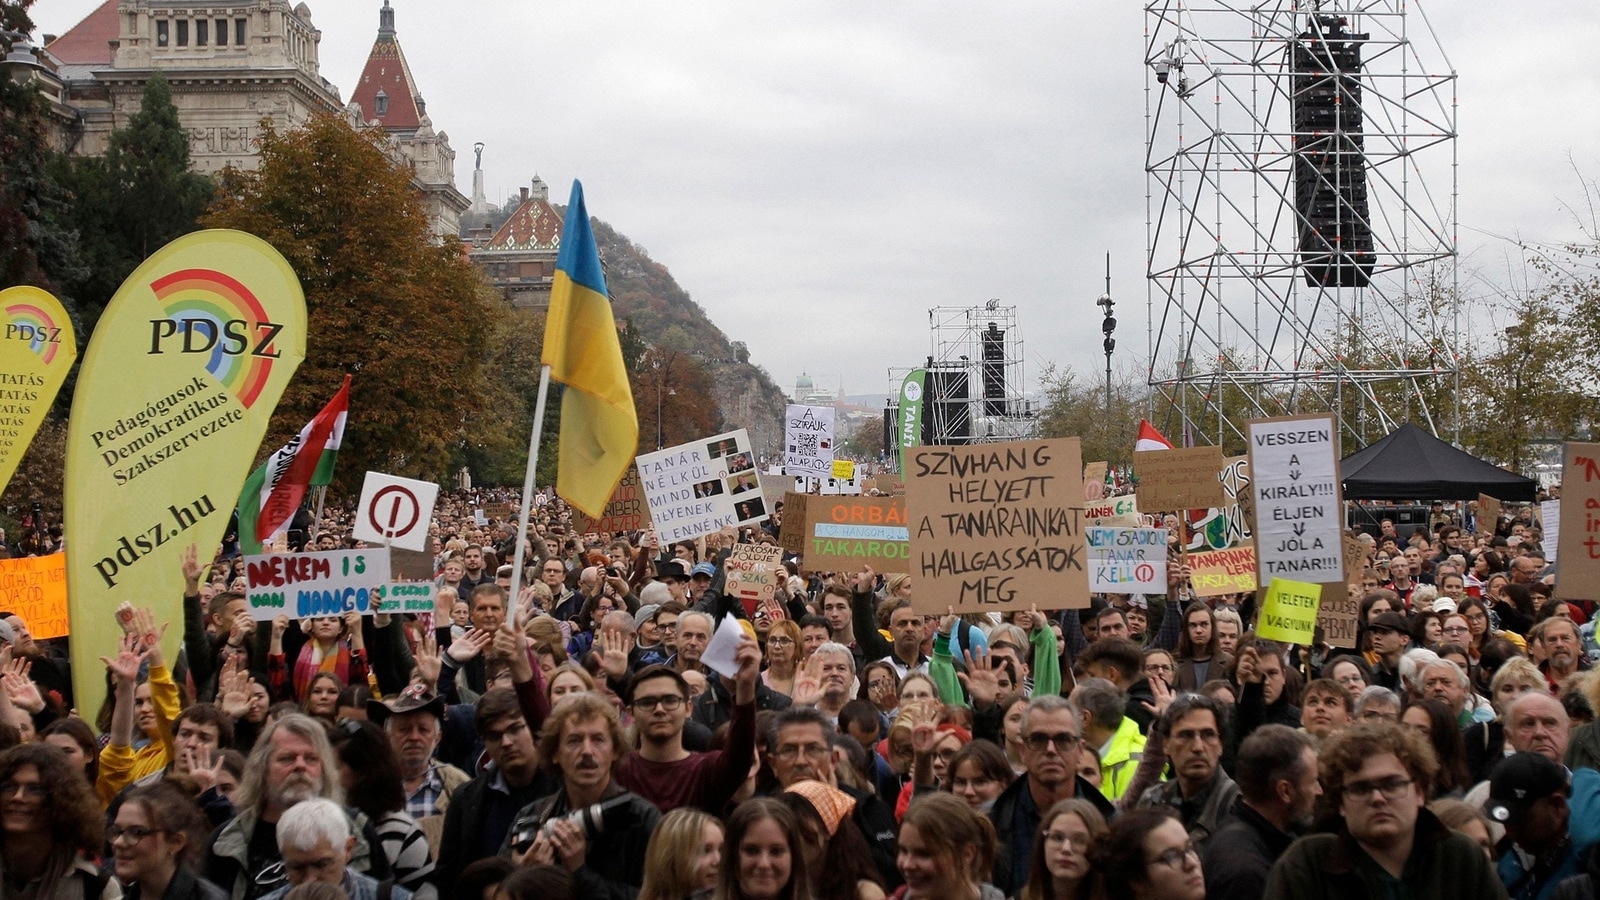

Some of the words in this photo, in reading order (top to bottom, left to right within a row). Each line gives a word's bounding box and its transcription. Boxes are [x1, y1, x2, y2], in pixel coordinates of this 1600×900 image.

[5, 323, 62, 343] PDSZ
[147, 318, 284, 358] PDSZ
[90, 376, 209, 449] Pedagógusok
[803, 408, 814, 420] A
[100, 391, 229, 468] Demokratikus
[1255, 430, 1329, 447] VESSZEN
[112, 407, 244, 486] Szakszervezete
[641, 451, 701, 475] TANÁR
[915, 445, 1051, 479] SZÍVHANG
[1289, 454, 1300, 466] A
[645, 465, 709, 491] NÉLKÜL
[649, 489, 690, 508] MIND
[949, 476, 1054, 503] HELYETT
[1260, 483, 1334, 500] KIRÁLY!!!
[654, 502, 713, 524] ILYENEK
[917, 515, 934, 539] A
[942, 503, 1087, 538] TANÁRAINKAT
[1273, 505, 1324, 521] ÉLJEN
[93, 494, 217, 589] pdsz.hu
[1277, 537, 1308, 552] JÓL
[1313, 538, 1324, 550] A
[921, 538, 1083, 578] HALLGASSÁTOK
[1095, 547, 1147, 565] TANÁR
[1187, 549, 1256, 570] TANÁRNAK
[1266, 556, 1338, 574] TANÁR!!!
[247, 556, 330, 589] NEKEM
[342, 555, 366, 577] IS
[1096, 566, 1134, 584] KELL
[959, 576, 1017, 604] MEG
[1276, 592, 1317, 610] VELETEK
[249, 592, 285, 608] VAN
[297, 586, 375, 617] HANGO
[1266, 614, 1314, 632] VAGYUNK
